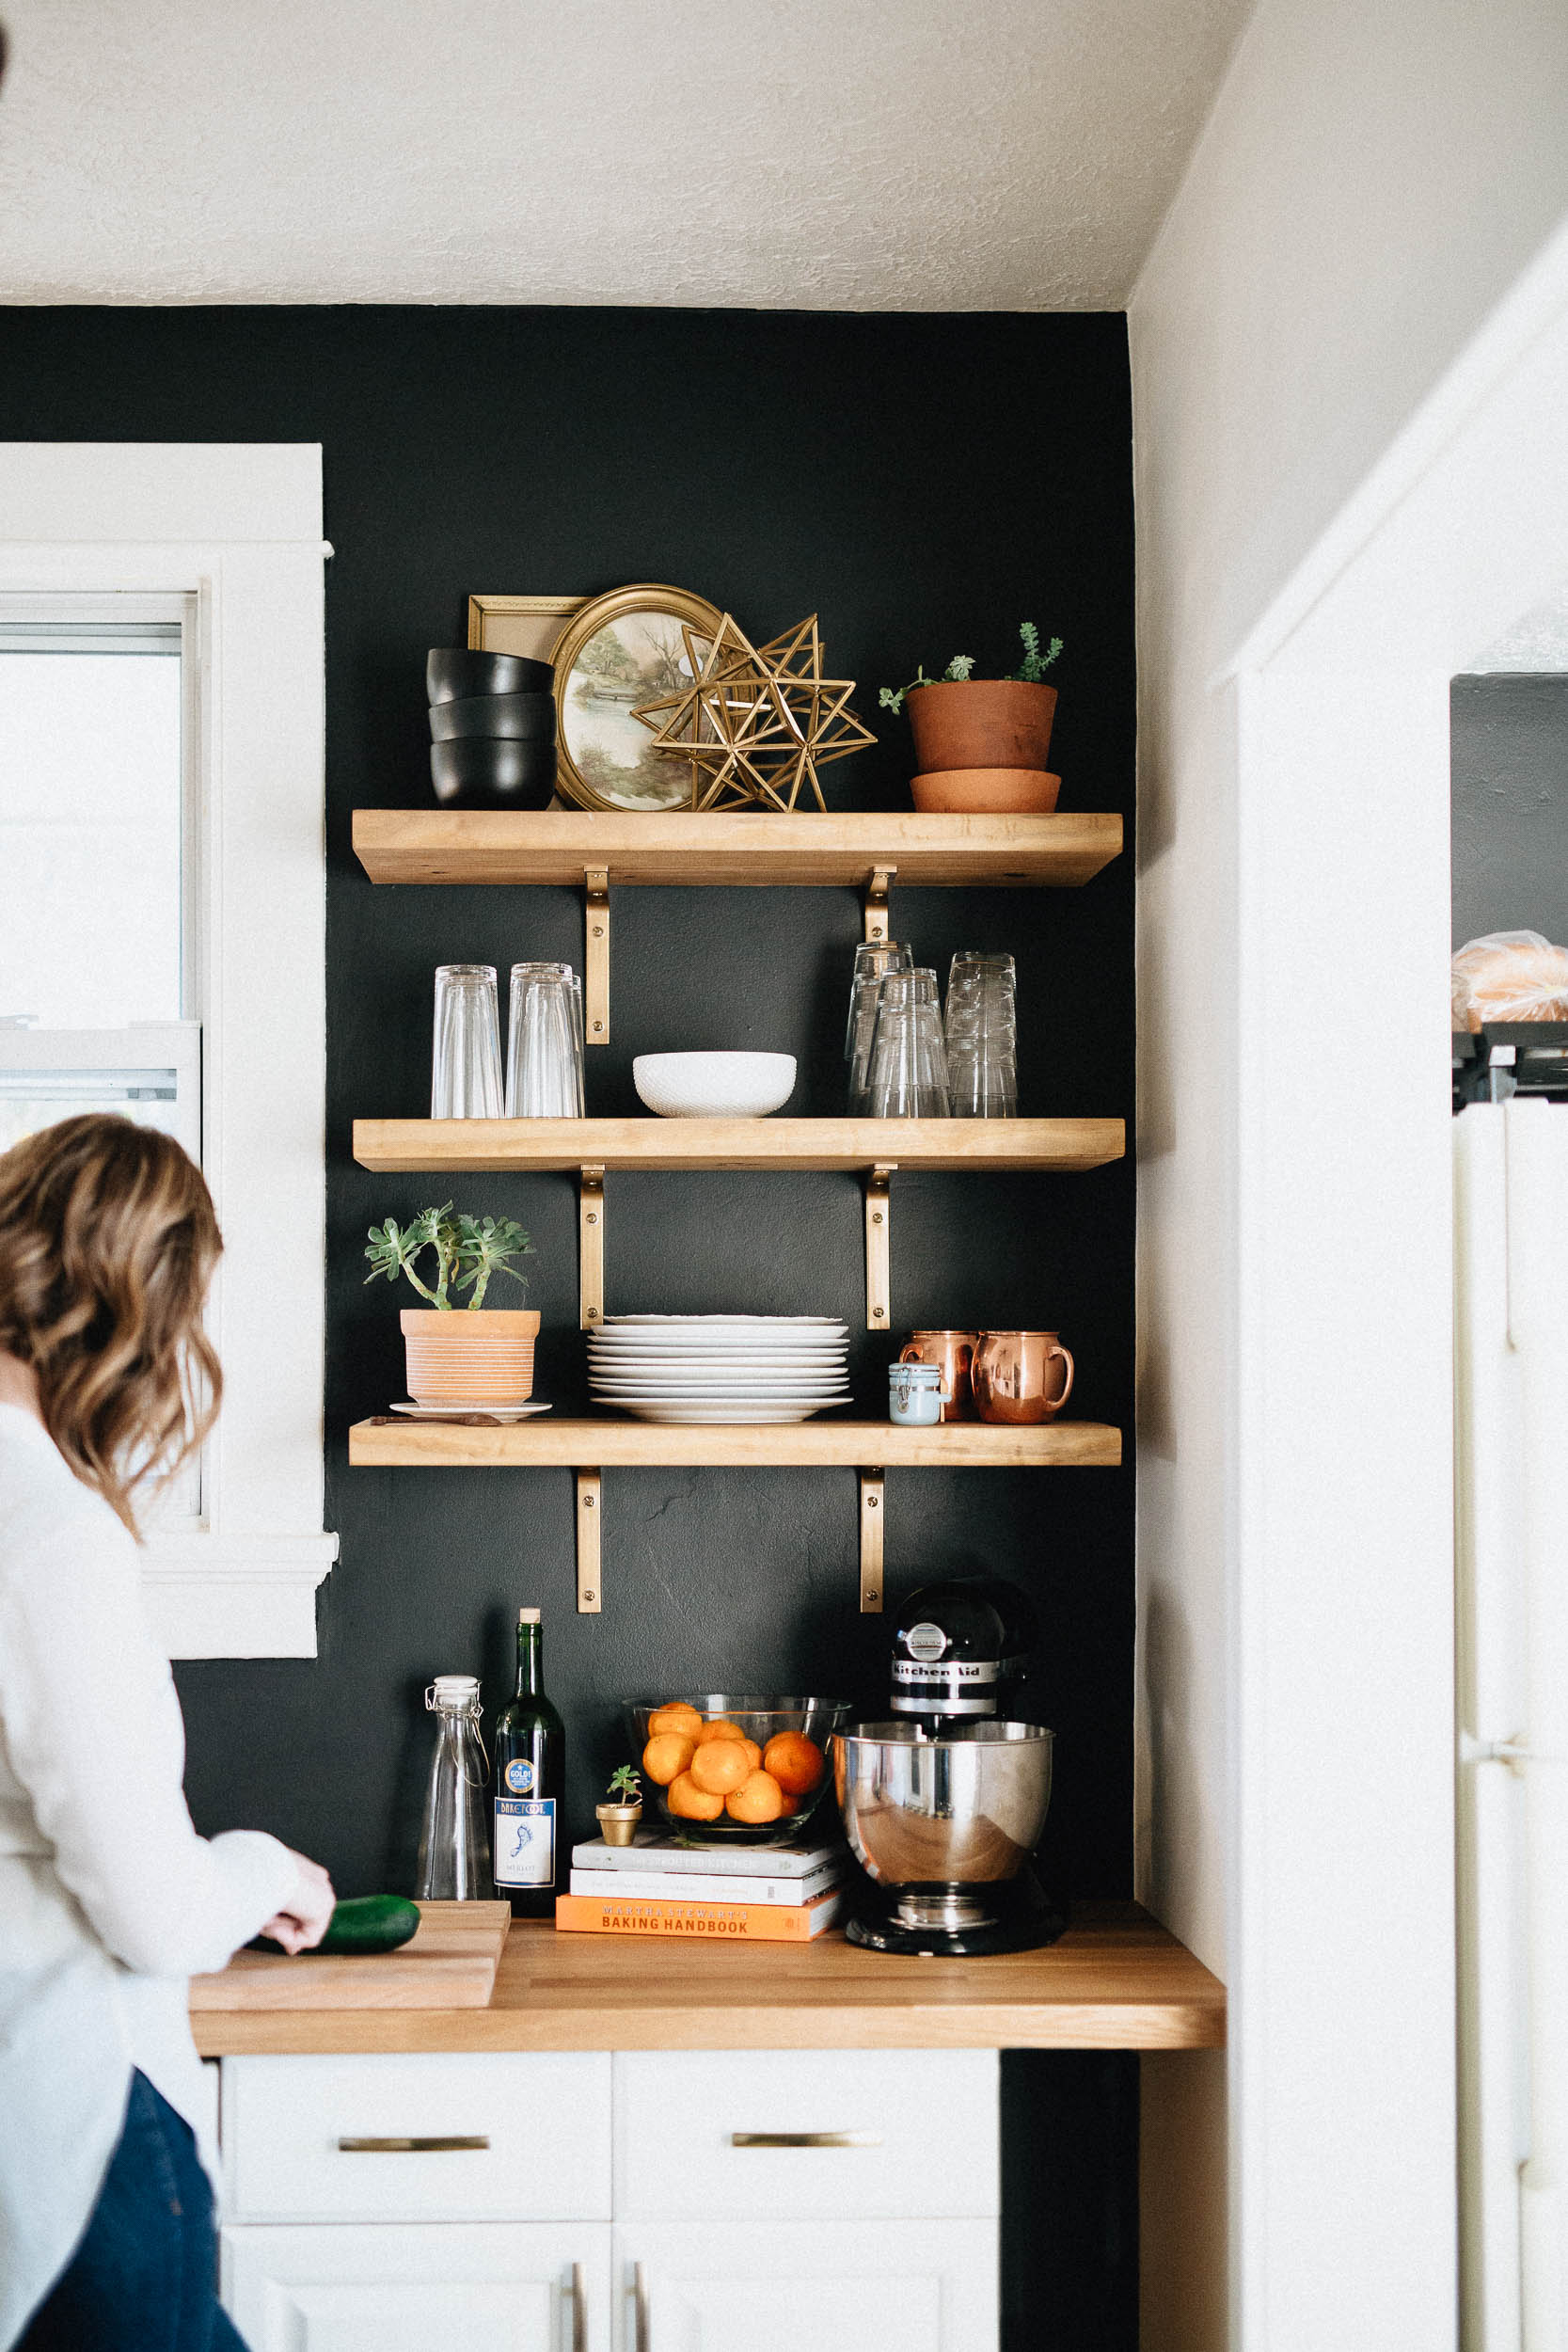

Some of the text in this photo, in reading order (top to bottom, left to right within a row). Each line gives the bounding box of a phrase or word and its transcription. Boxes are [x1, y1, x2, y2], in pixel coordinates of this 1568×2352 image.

[603, 1905, 748, 1920] MARTHA STEWART'S
[602, 1916, 748, 1933] BAKING HANDBOOK
